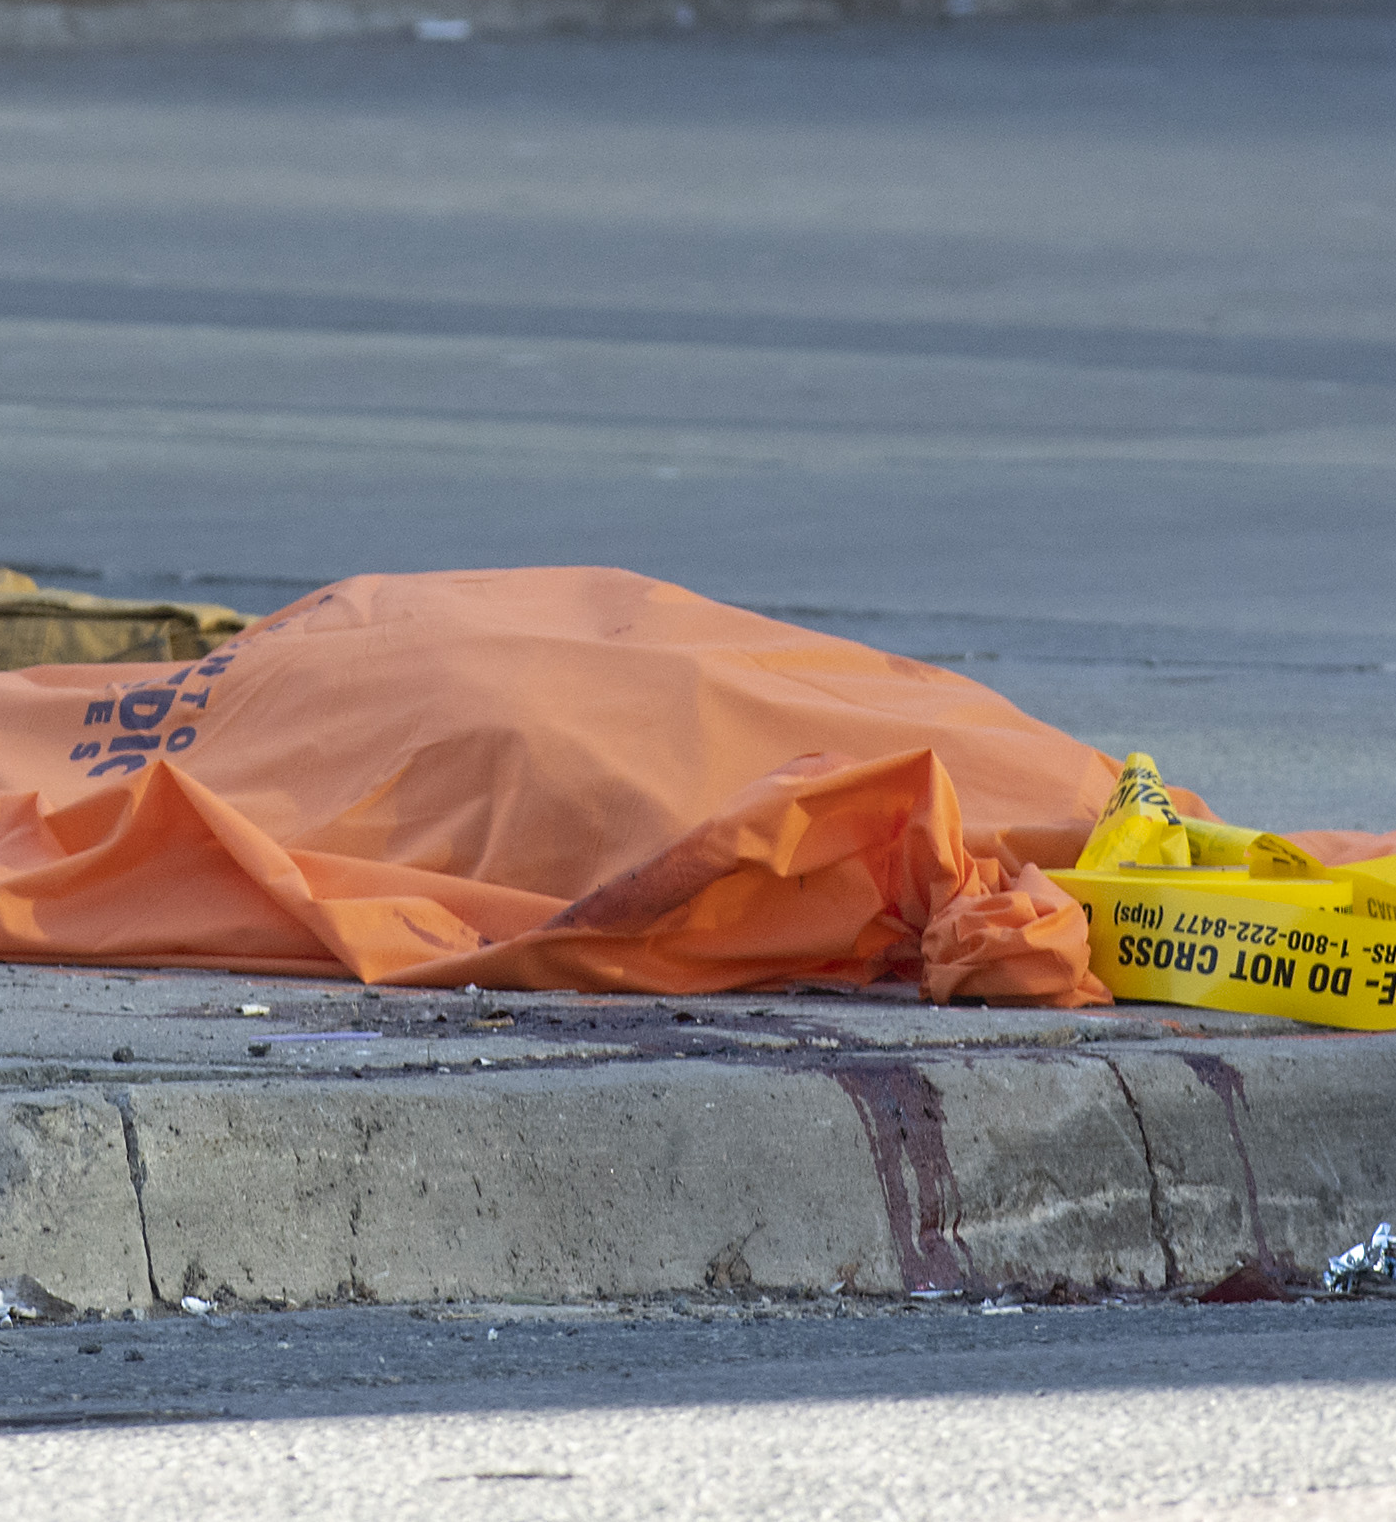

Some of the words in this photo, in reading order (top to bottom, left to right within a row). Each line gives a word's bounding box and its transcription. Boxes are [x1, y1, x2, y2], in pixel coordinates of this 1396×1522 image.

[1113, 900, 1164, 930] (tips)
[1118, 934, 1220, 976] CROSS
[1172, 912, 1350, 959] 1-800-222-8477
[1229, 949, 1297, 989] NOT
[1308, 963, 1353, 997] DO
